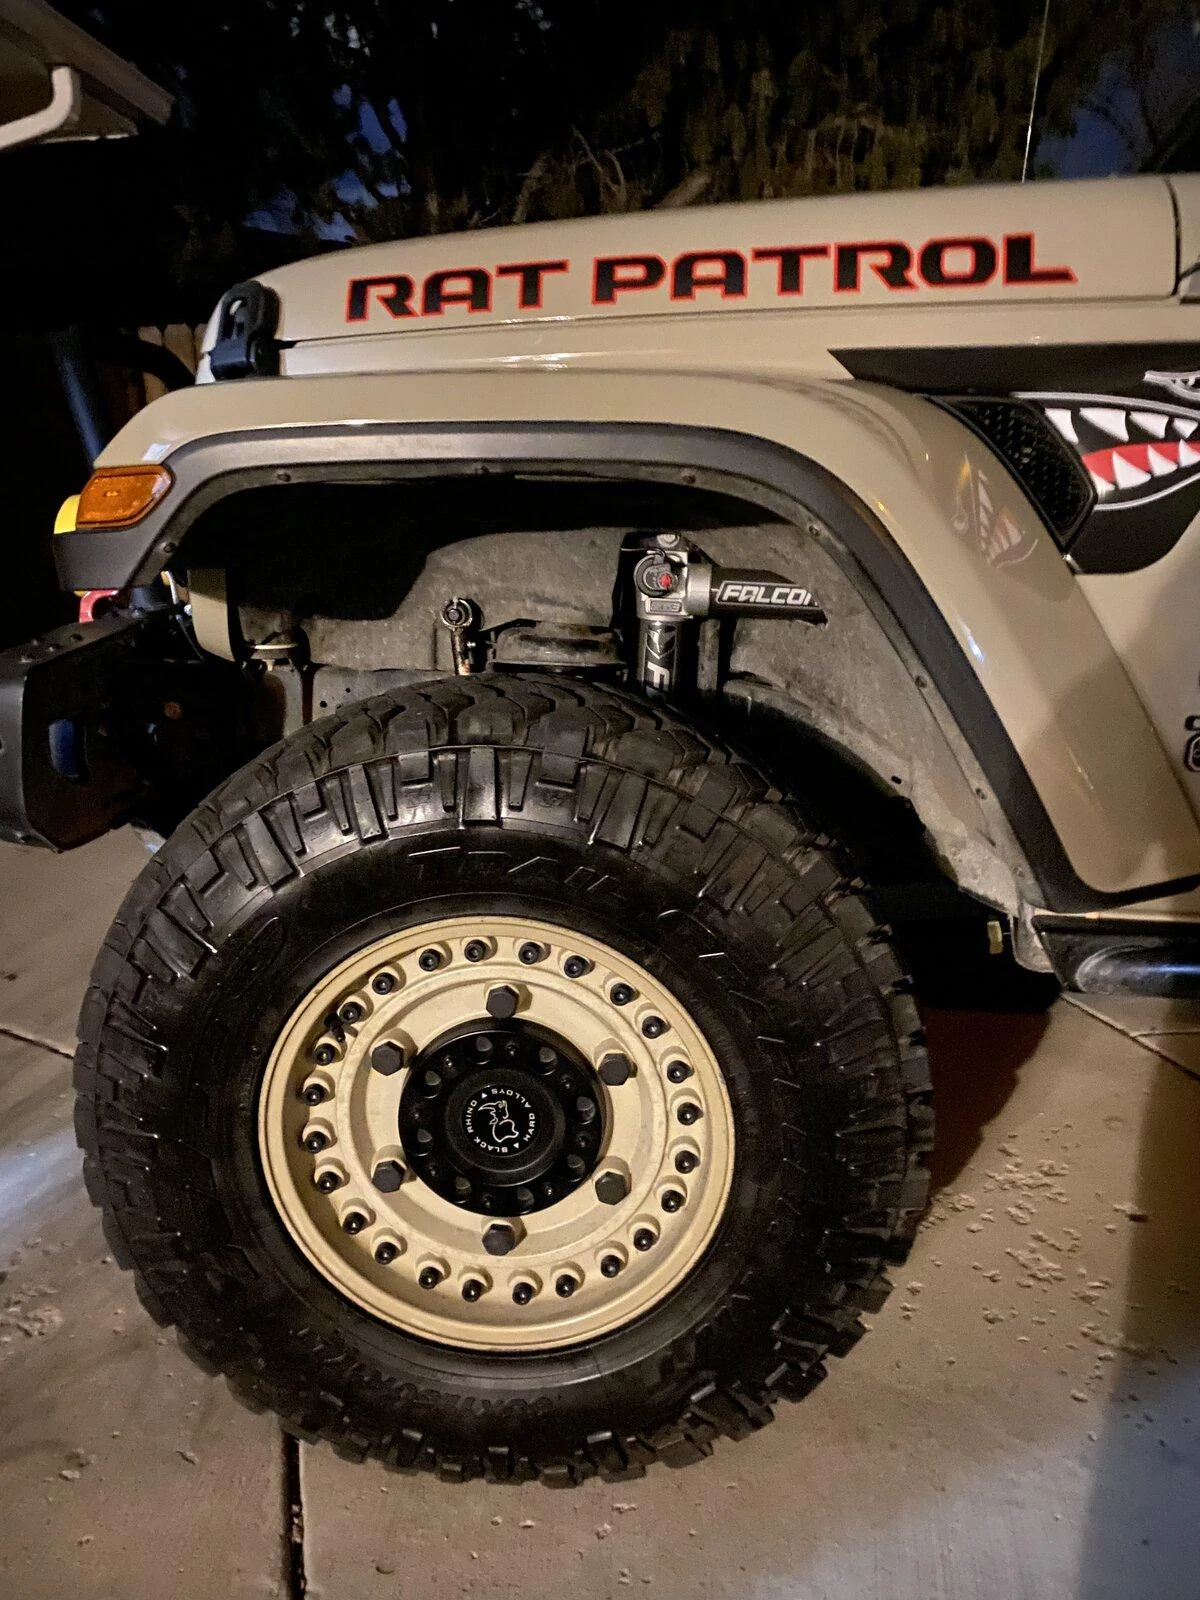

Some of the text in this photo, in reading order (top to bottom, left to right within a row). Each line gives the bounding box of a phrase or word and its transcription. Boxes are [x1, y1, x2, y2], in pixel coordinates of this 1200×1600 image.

[346, 232, 1078, 322] RAT PATROL
[465, 1099, 508, 1153] BLACK RHINO
[490, 1088, 536, 1142] HARD ALLOYS
